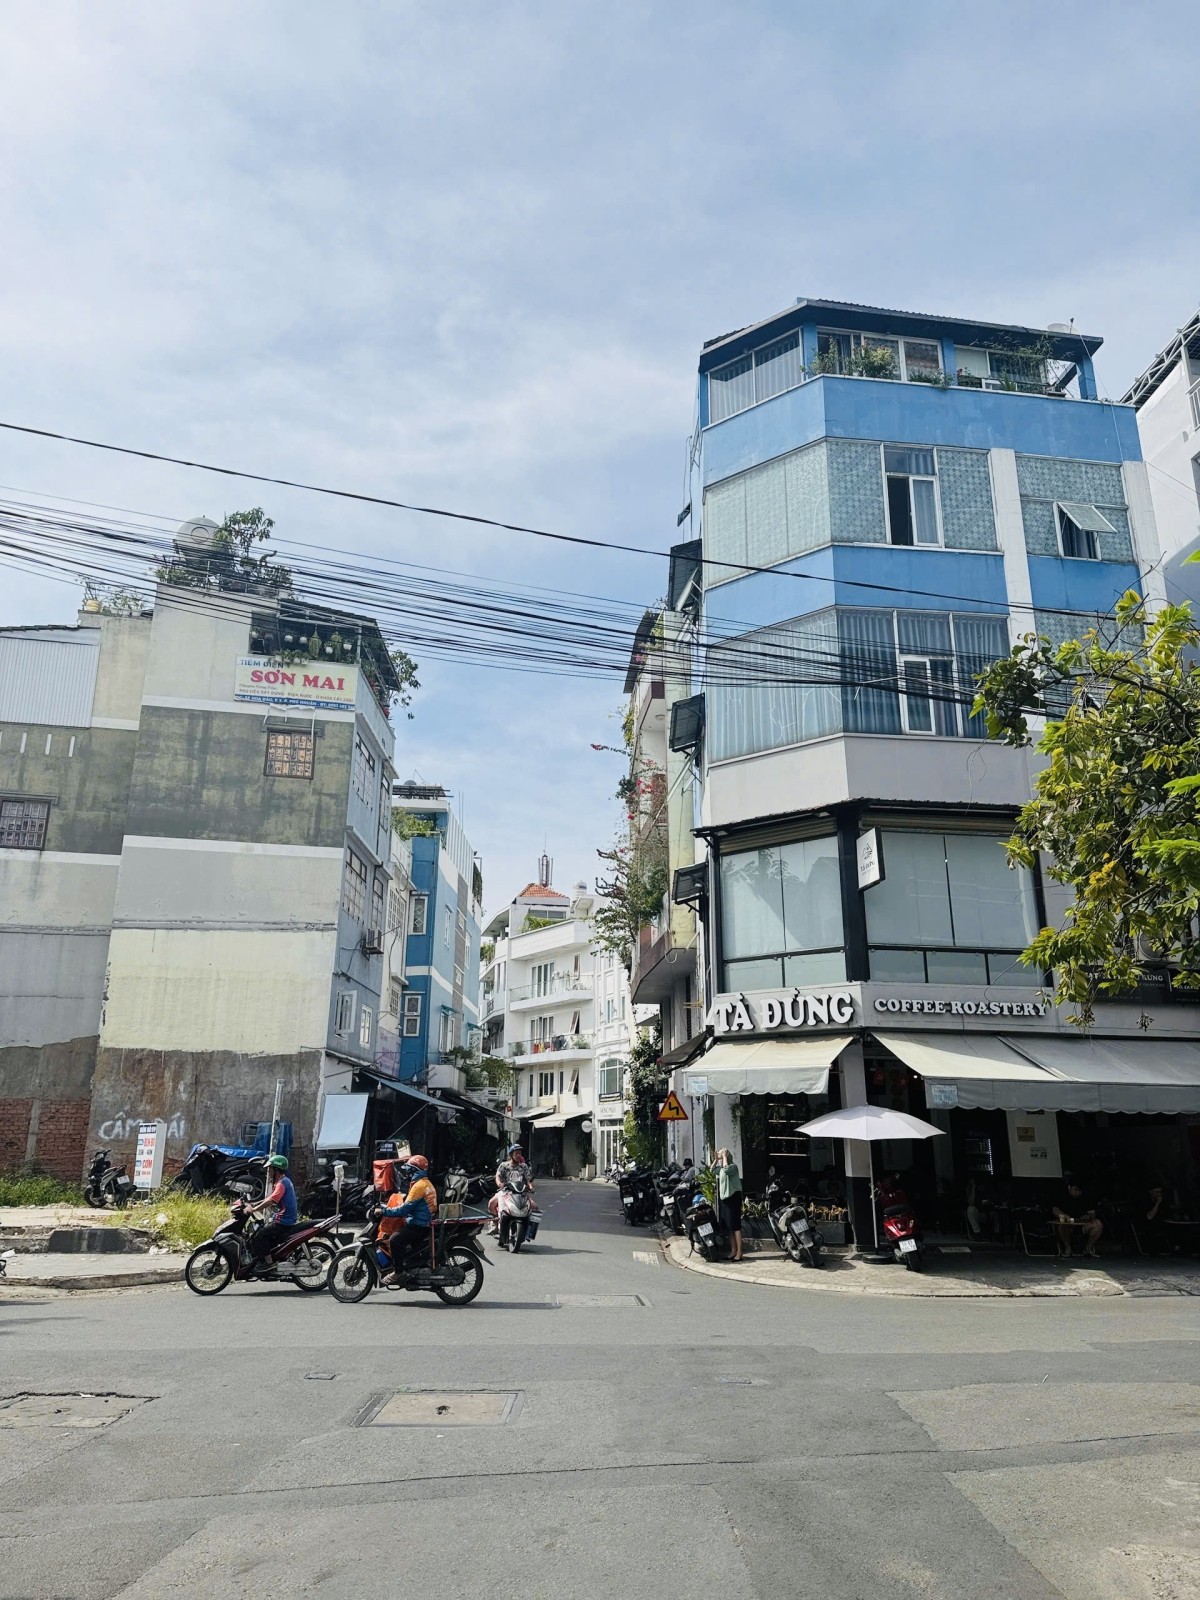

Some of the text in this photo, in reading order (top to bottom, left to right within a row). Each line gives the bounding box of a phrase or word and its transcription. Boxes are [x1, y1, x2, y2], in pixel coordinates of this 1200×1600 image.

[250, 669, 345, 690] SƠN MAI
[874, 998, 1047, 1017] COFFEE ROASTERY
[154, 1112, 187, 1139] ÁI
